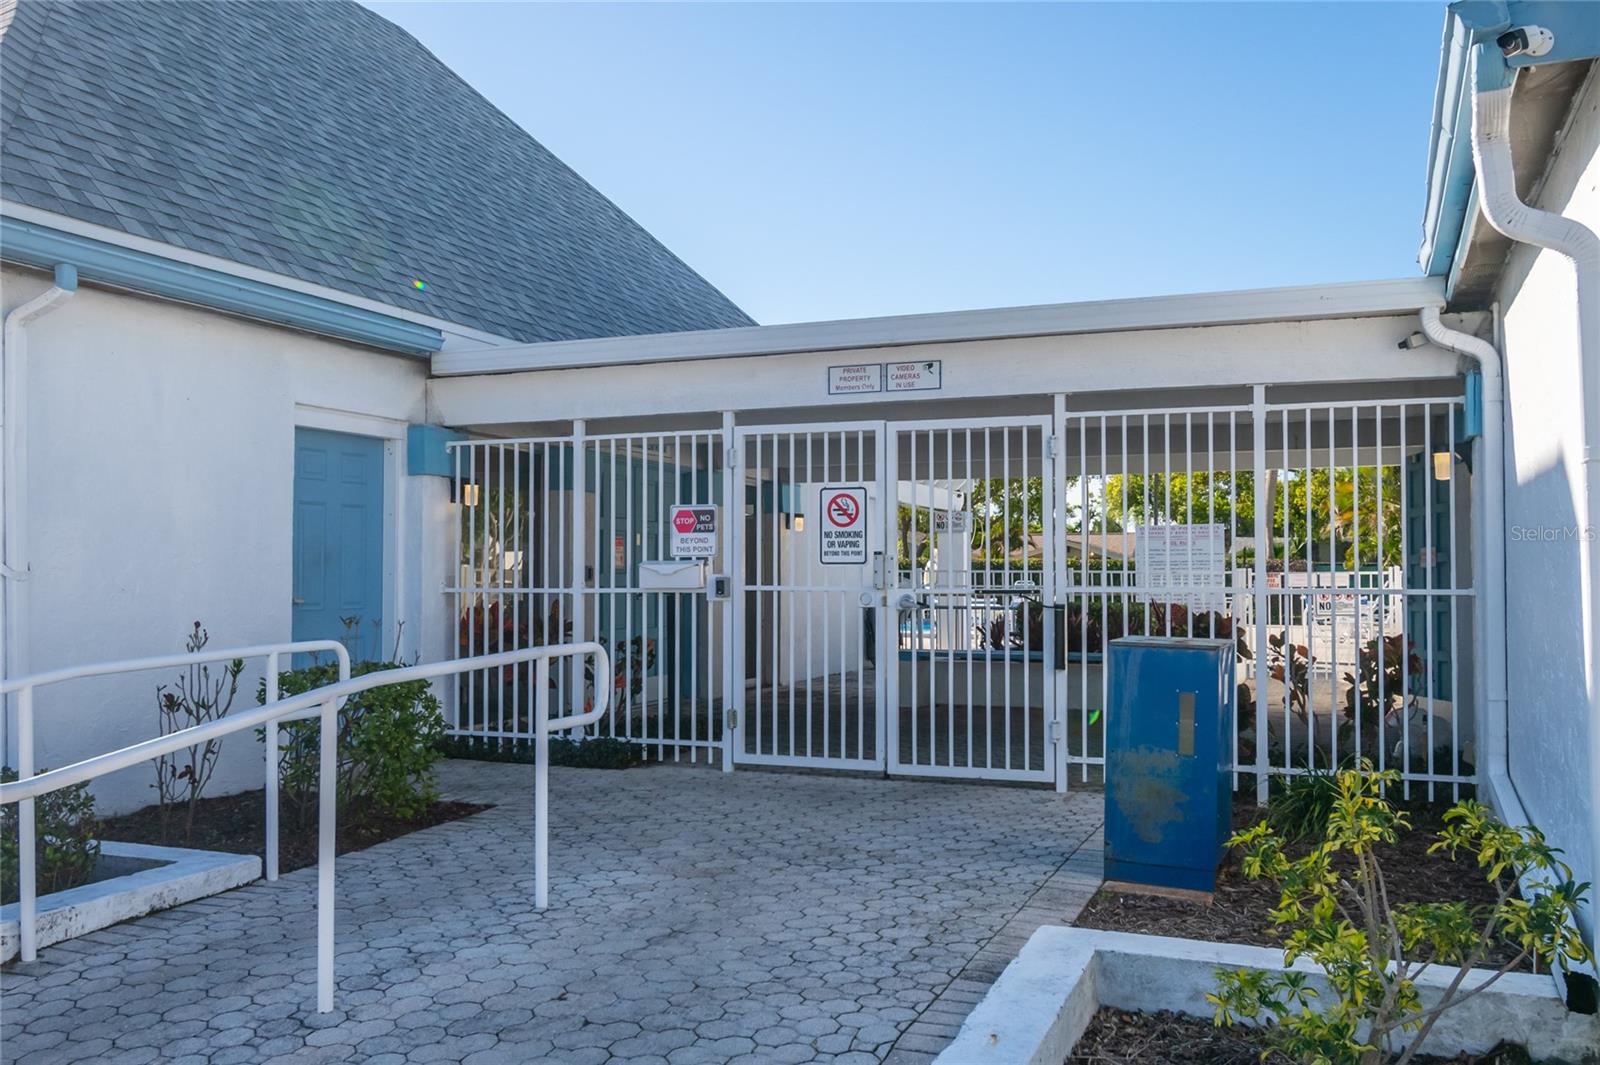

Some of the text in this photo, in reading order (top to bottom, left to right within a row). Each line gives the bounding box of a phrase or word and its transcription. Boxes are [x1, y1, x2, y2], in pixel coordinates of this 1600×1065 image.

[842, 366, 867, 374] PRIVATE
[896, 364, 915, 372] VIDEO
[839, 375, 871, 383] PROPERTY
[890, 373, 920, 381] CAMERAS
[861, 383, 875, 391] Only
[675, 517, 694, 525] STOP
[699, 514, 711, 522] NO
[696, 523, 714, 531] PETS
[823, 530, 863, 539] NO SMOKING
[827, 540, 860, 549] OR VAPING
[1319, 601, 1332, 611] NO
